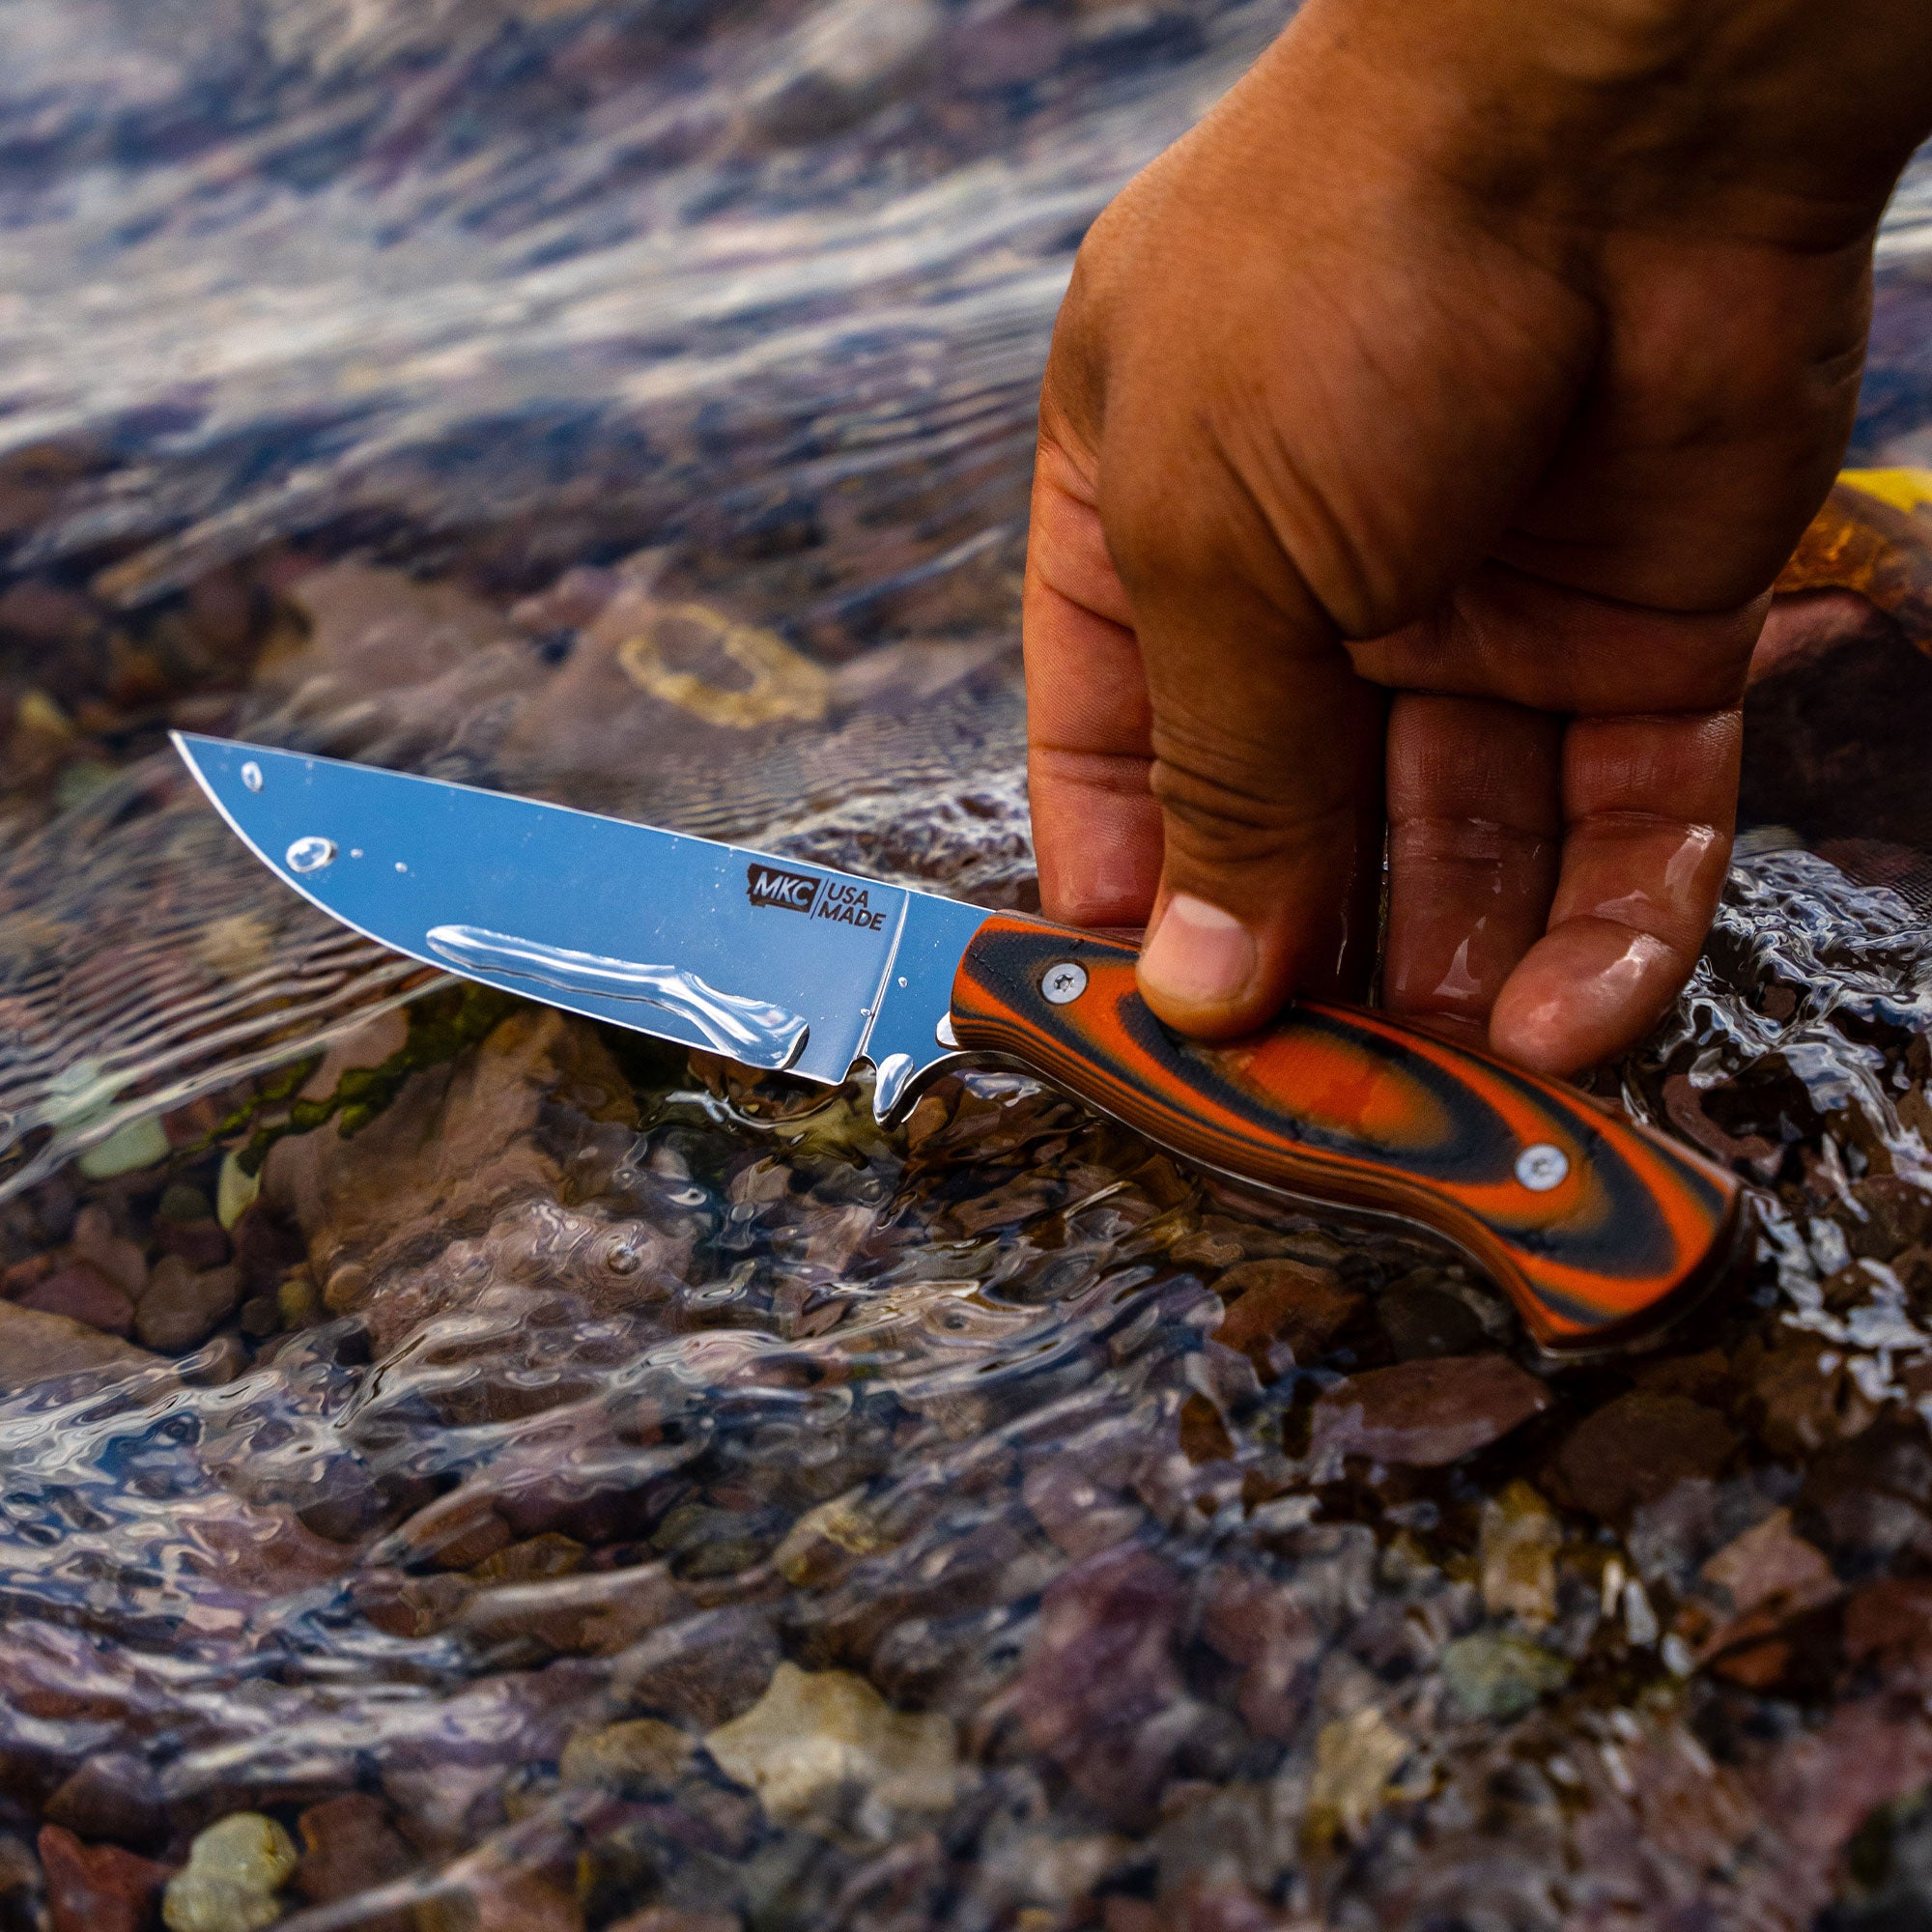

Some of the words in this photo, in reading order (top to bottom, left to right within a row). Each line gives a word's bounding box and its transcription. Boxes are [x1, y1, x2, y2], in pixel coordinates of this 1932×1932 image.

[753, 871, 814, 906] MKC
[827, 883, 868, 908] USA
[817, 900, 887, 931] MADE
